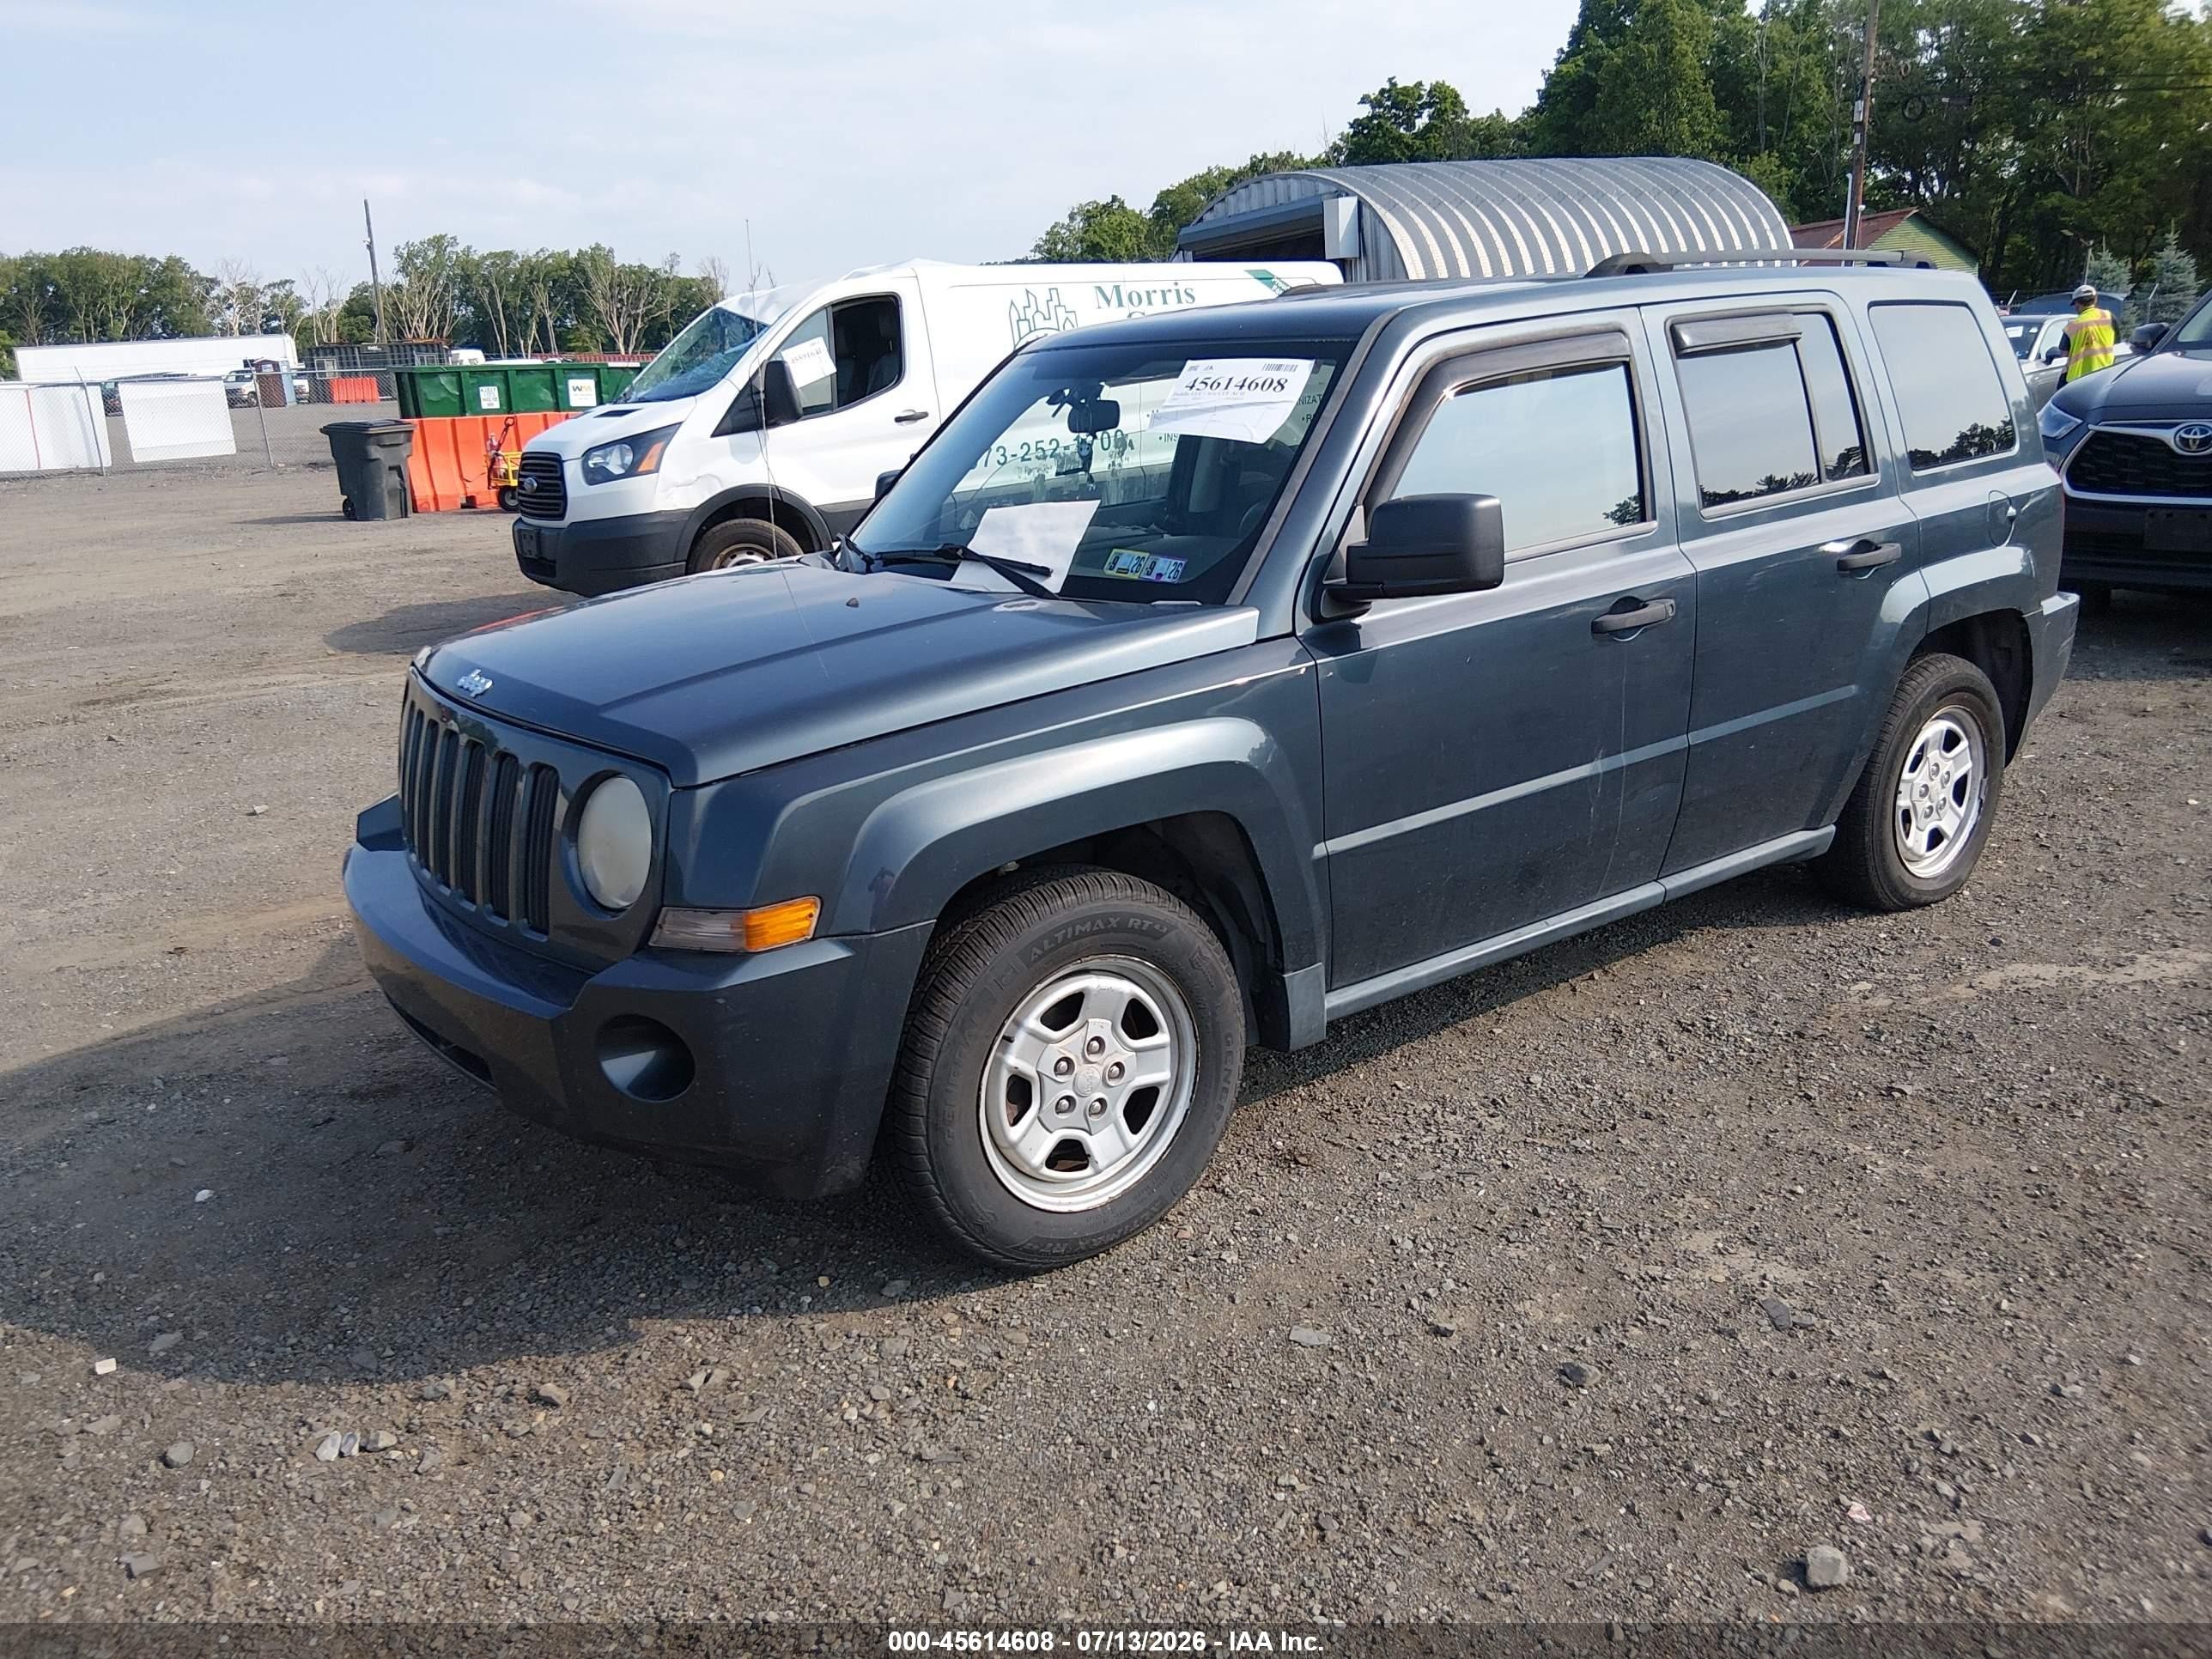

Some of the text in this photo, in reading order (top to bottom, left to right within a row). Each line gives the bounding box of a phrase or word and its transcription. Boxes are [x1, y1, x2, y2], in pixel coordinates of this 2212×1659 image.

[1094, 282, 1196, 309] Morris
[1185, 376, 1288, 393] 45614608
[1297, 394, 1322, 406] NIZAT
[1164, 433, 1179, 443] INS
[1131, 556, 1146, 574] 26
[1168, 562, 1182, 580] 26
[1030, 917, 1120, 962] ALTIMAX
